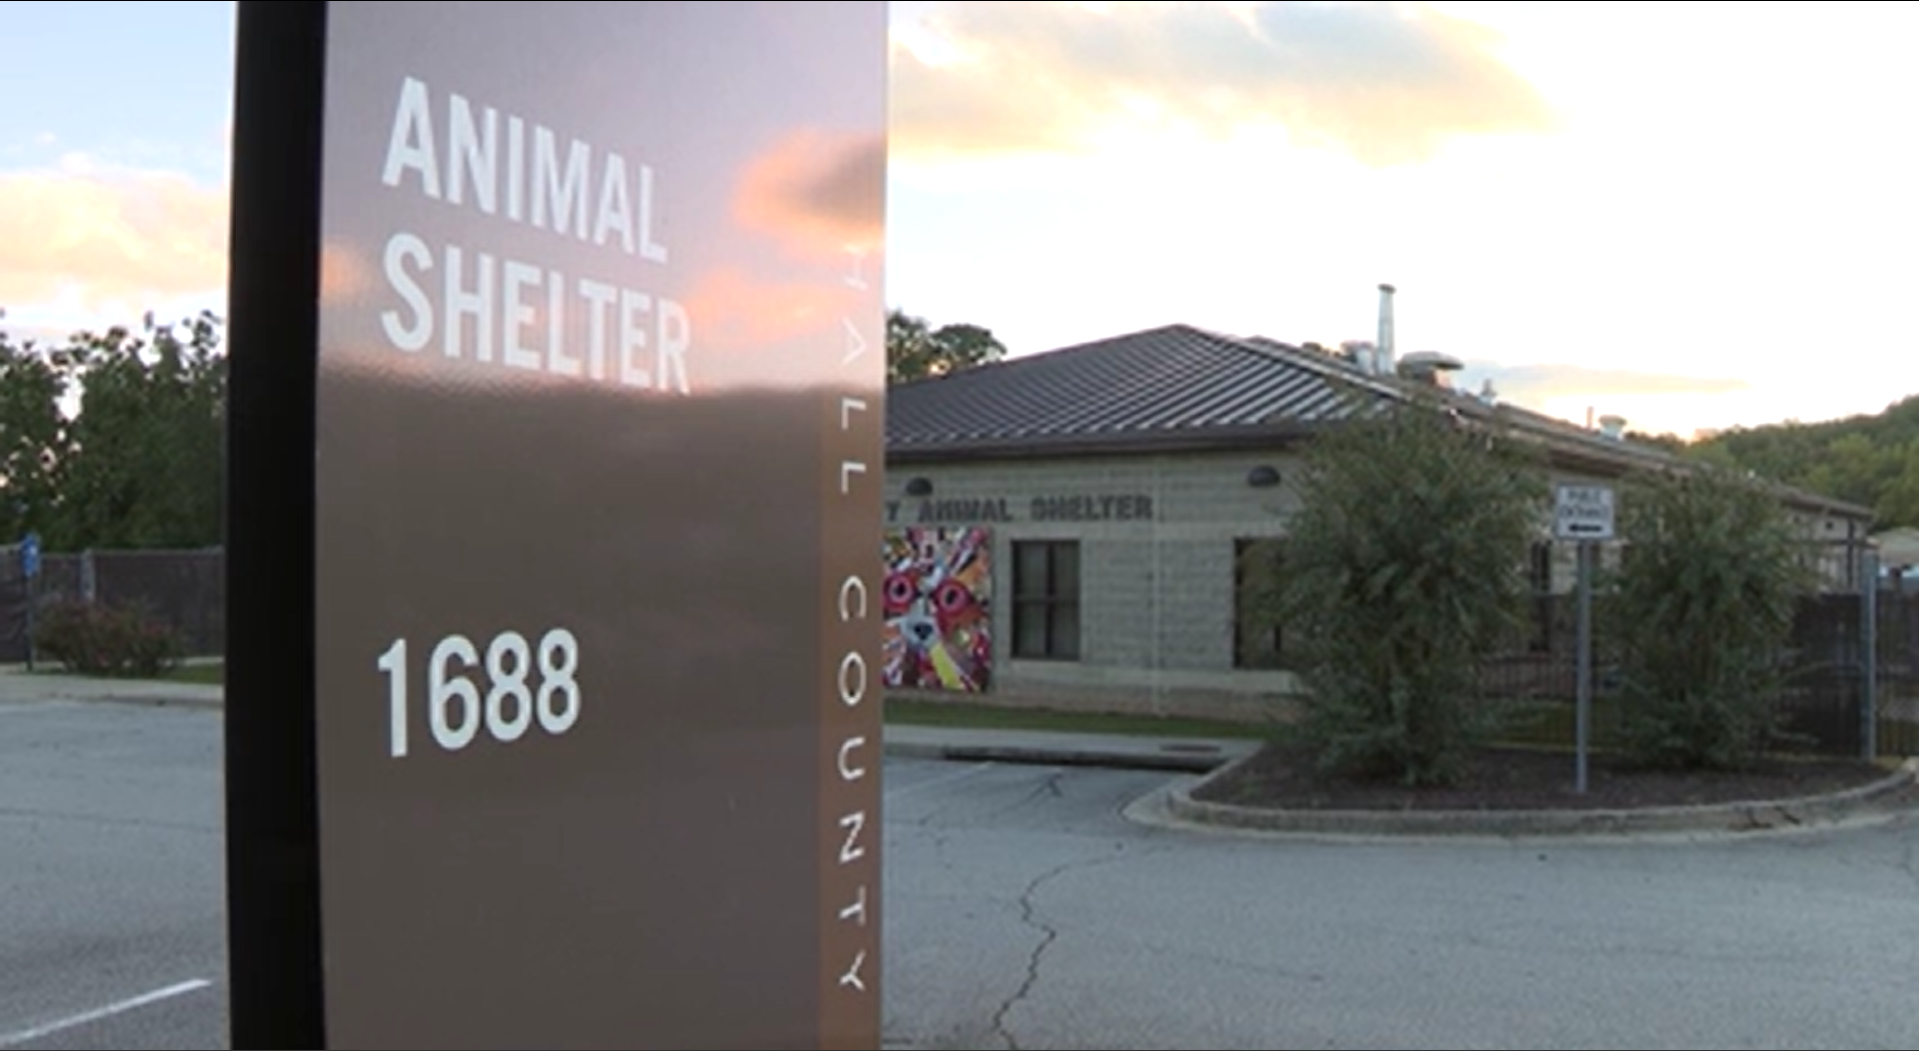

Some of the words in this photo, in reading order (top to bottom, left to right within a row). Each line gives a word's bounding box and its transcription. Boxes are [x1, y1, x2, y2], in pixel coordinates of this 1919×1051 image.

[382, 77, 668, 264] ANIMAL
[380, 233, 692, 396] SHELTER
[841, 242, 868, 493] HALL
[917, 499, 1014, 523] ANIMAL
[1030, 495, 1154, 521] SHELTER
[378, 628, 580, 757] 1688
[838, 575, 867, 990] COUNTY
